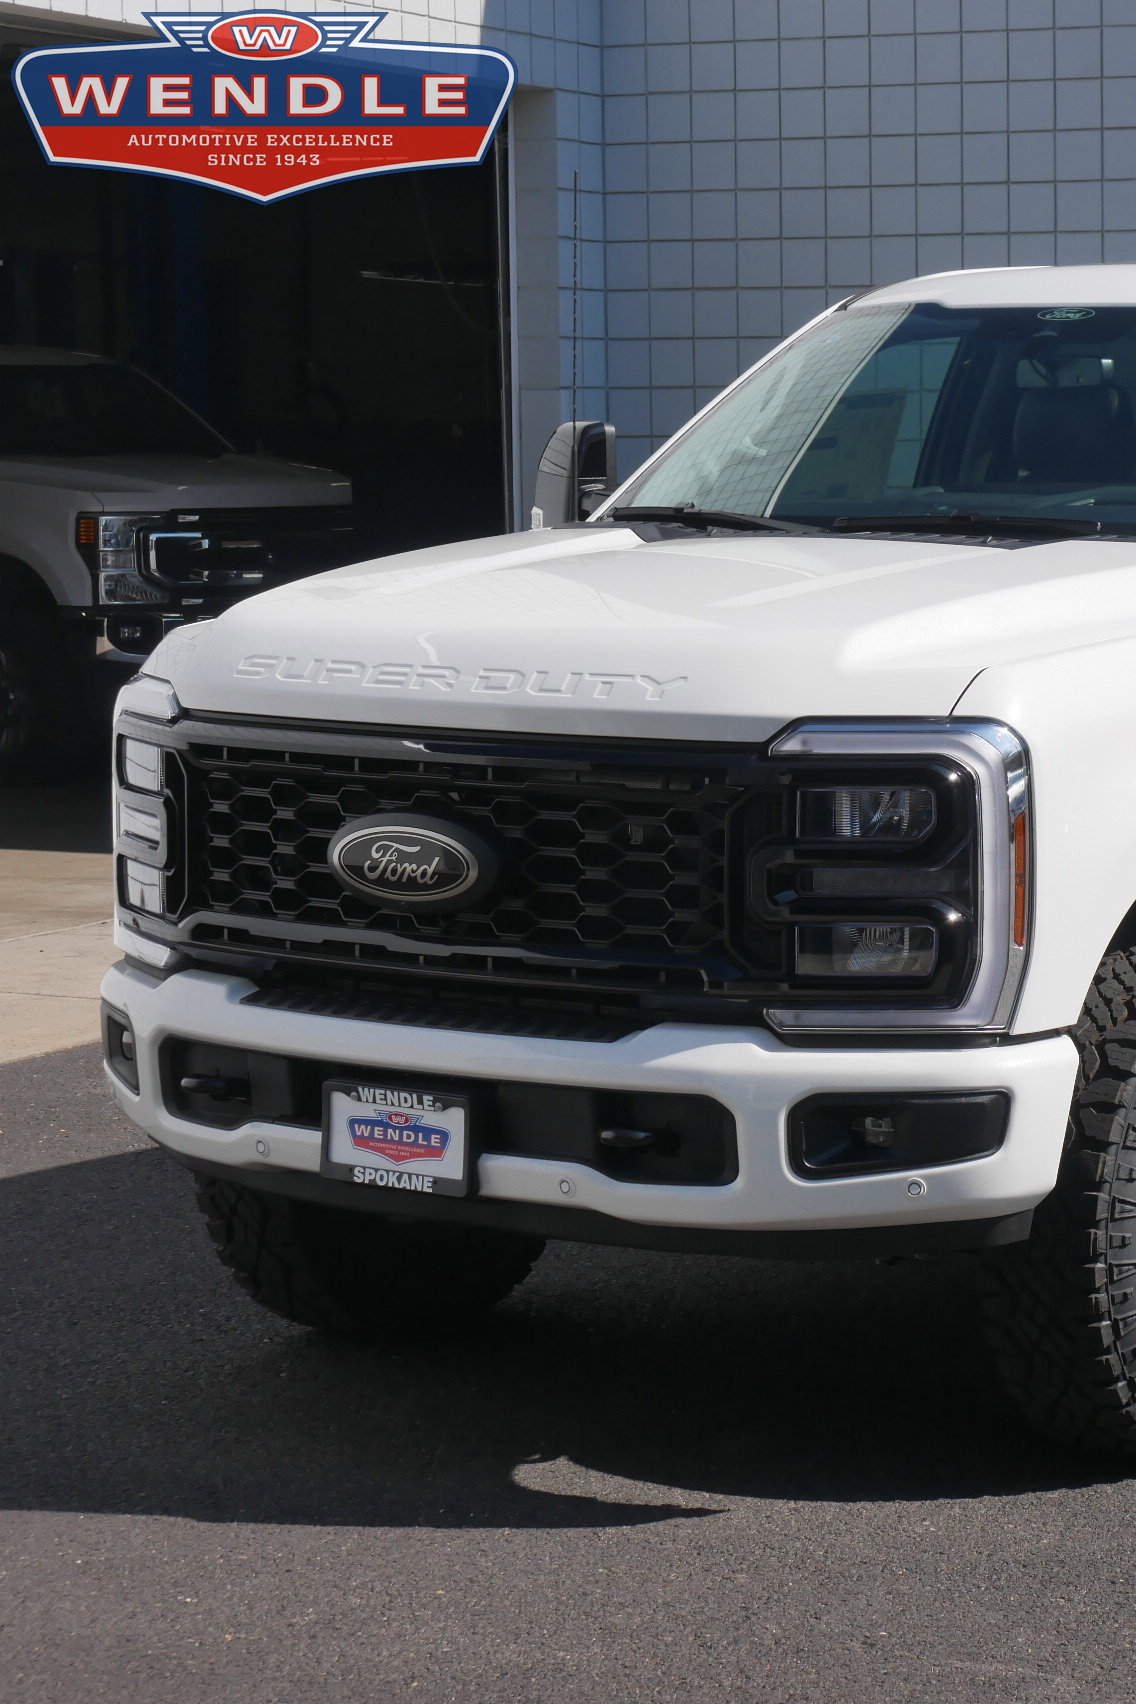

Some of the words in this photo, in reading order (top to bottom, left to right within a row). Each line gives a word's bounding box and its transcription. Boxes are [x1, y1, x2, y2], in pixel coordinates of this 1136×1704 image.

[233, 654, 461, 691] SUPER
[470, 668, 688, 700] DUTY
[363, 839, 440, 886] Ford
[357, 1086, 435, 1111] WENDLE
[354, 1123, 442, 1147] WENDLE
[353, 1166, 433, 1193] SPOKANE
